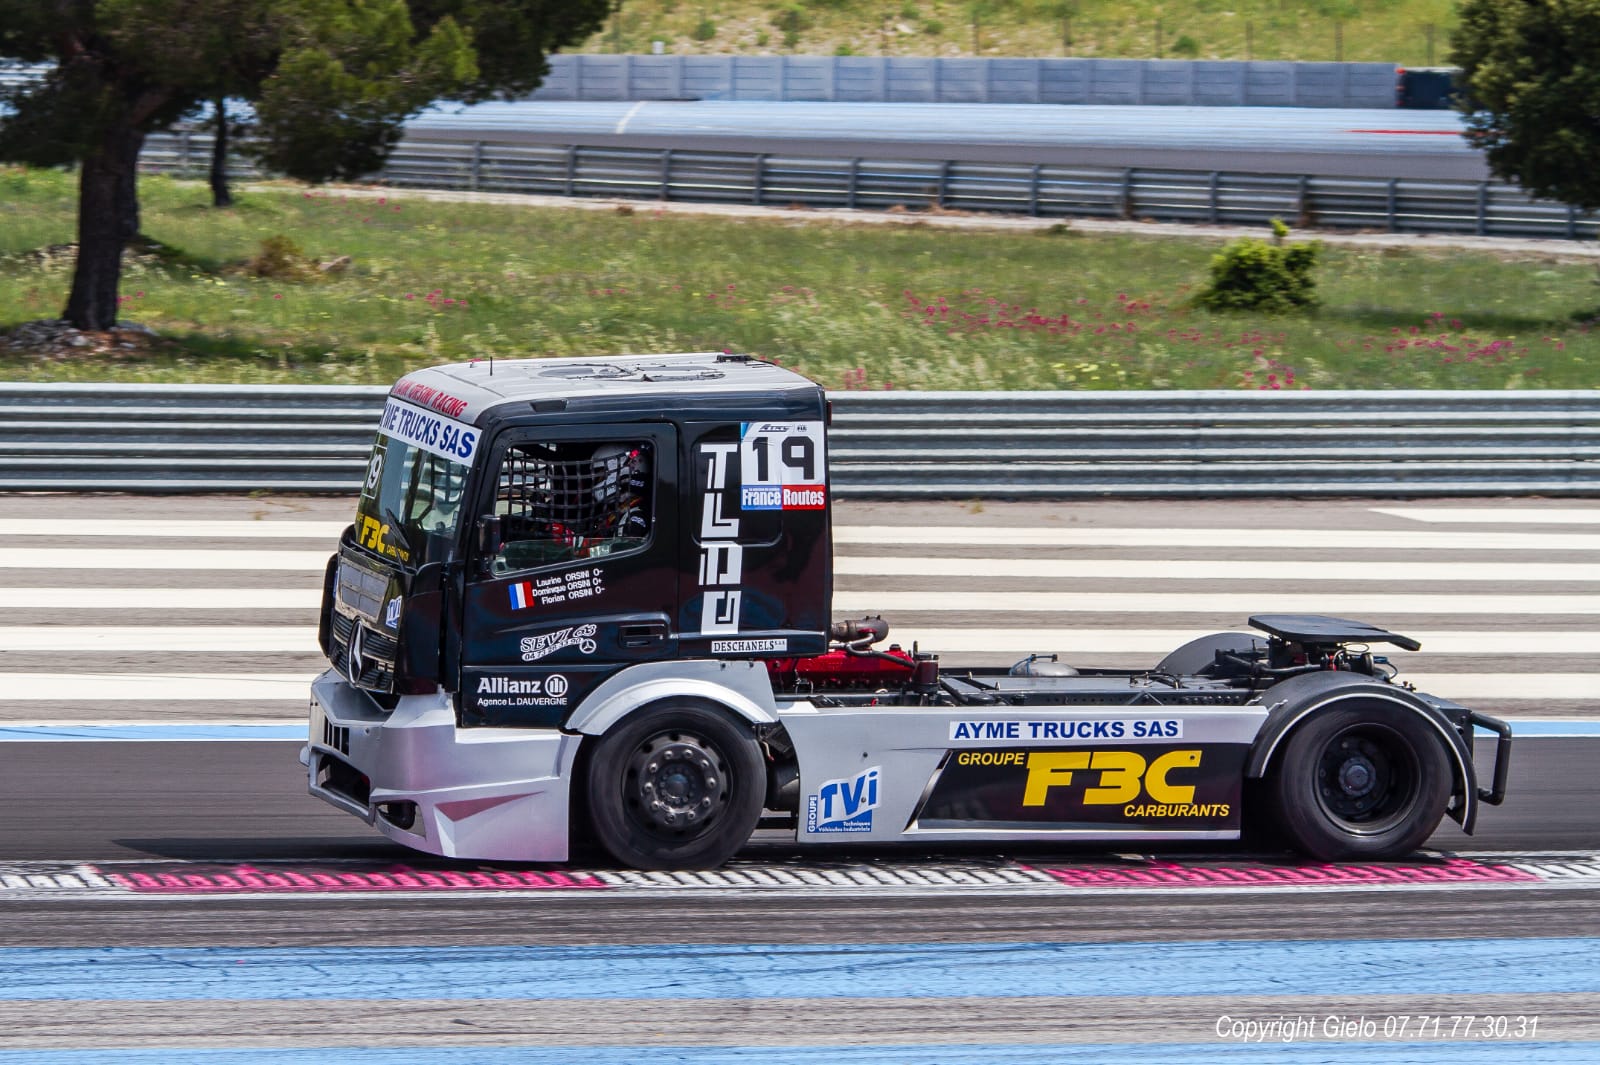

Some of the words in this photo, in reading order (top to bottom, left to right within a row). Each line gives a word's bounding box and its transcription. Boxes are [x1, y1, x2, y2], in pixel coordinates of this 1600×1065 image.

[431, 392, 467, 417] RACING
[380, 402, 400, 430] YME
[397, 408, 441, 447] TRUCKS
[439, 424, 475, 459] SAS
[752, 436, 815, 482] 19
[742, 488, 781, 506] France
[783, 488, 825, 506] Routes
[359, 515, 390, 554] F3C
[565, 570, 590, 582] ORSINI
[532, 584, 567, 597] Dominique
[567, 579, 591, 591] ORSINI
[541, 594, 566, 605] Florian
[568, 588, 593, 600] ORSINI
[714, 640, 774, 652] DESCHANELS
[477, 677, 541, 694] Allianz
[477, 697, 507, 707] Agence
[954, 722, 1020, 739] AYME
[1028, 721, 1125, 738] TRUCKS
[1133, 720, 1179, 737] SAS
[958, 752, 1026, 765] GROUPE
[1022, 750, 1203, 806] F3C
[820, 771, 878, 819] TVi
[808, 796, 817, 832] GROUPE
[1123, 804, 1230, 817] CARBURANTS
